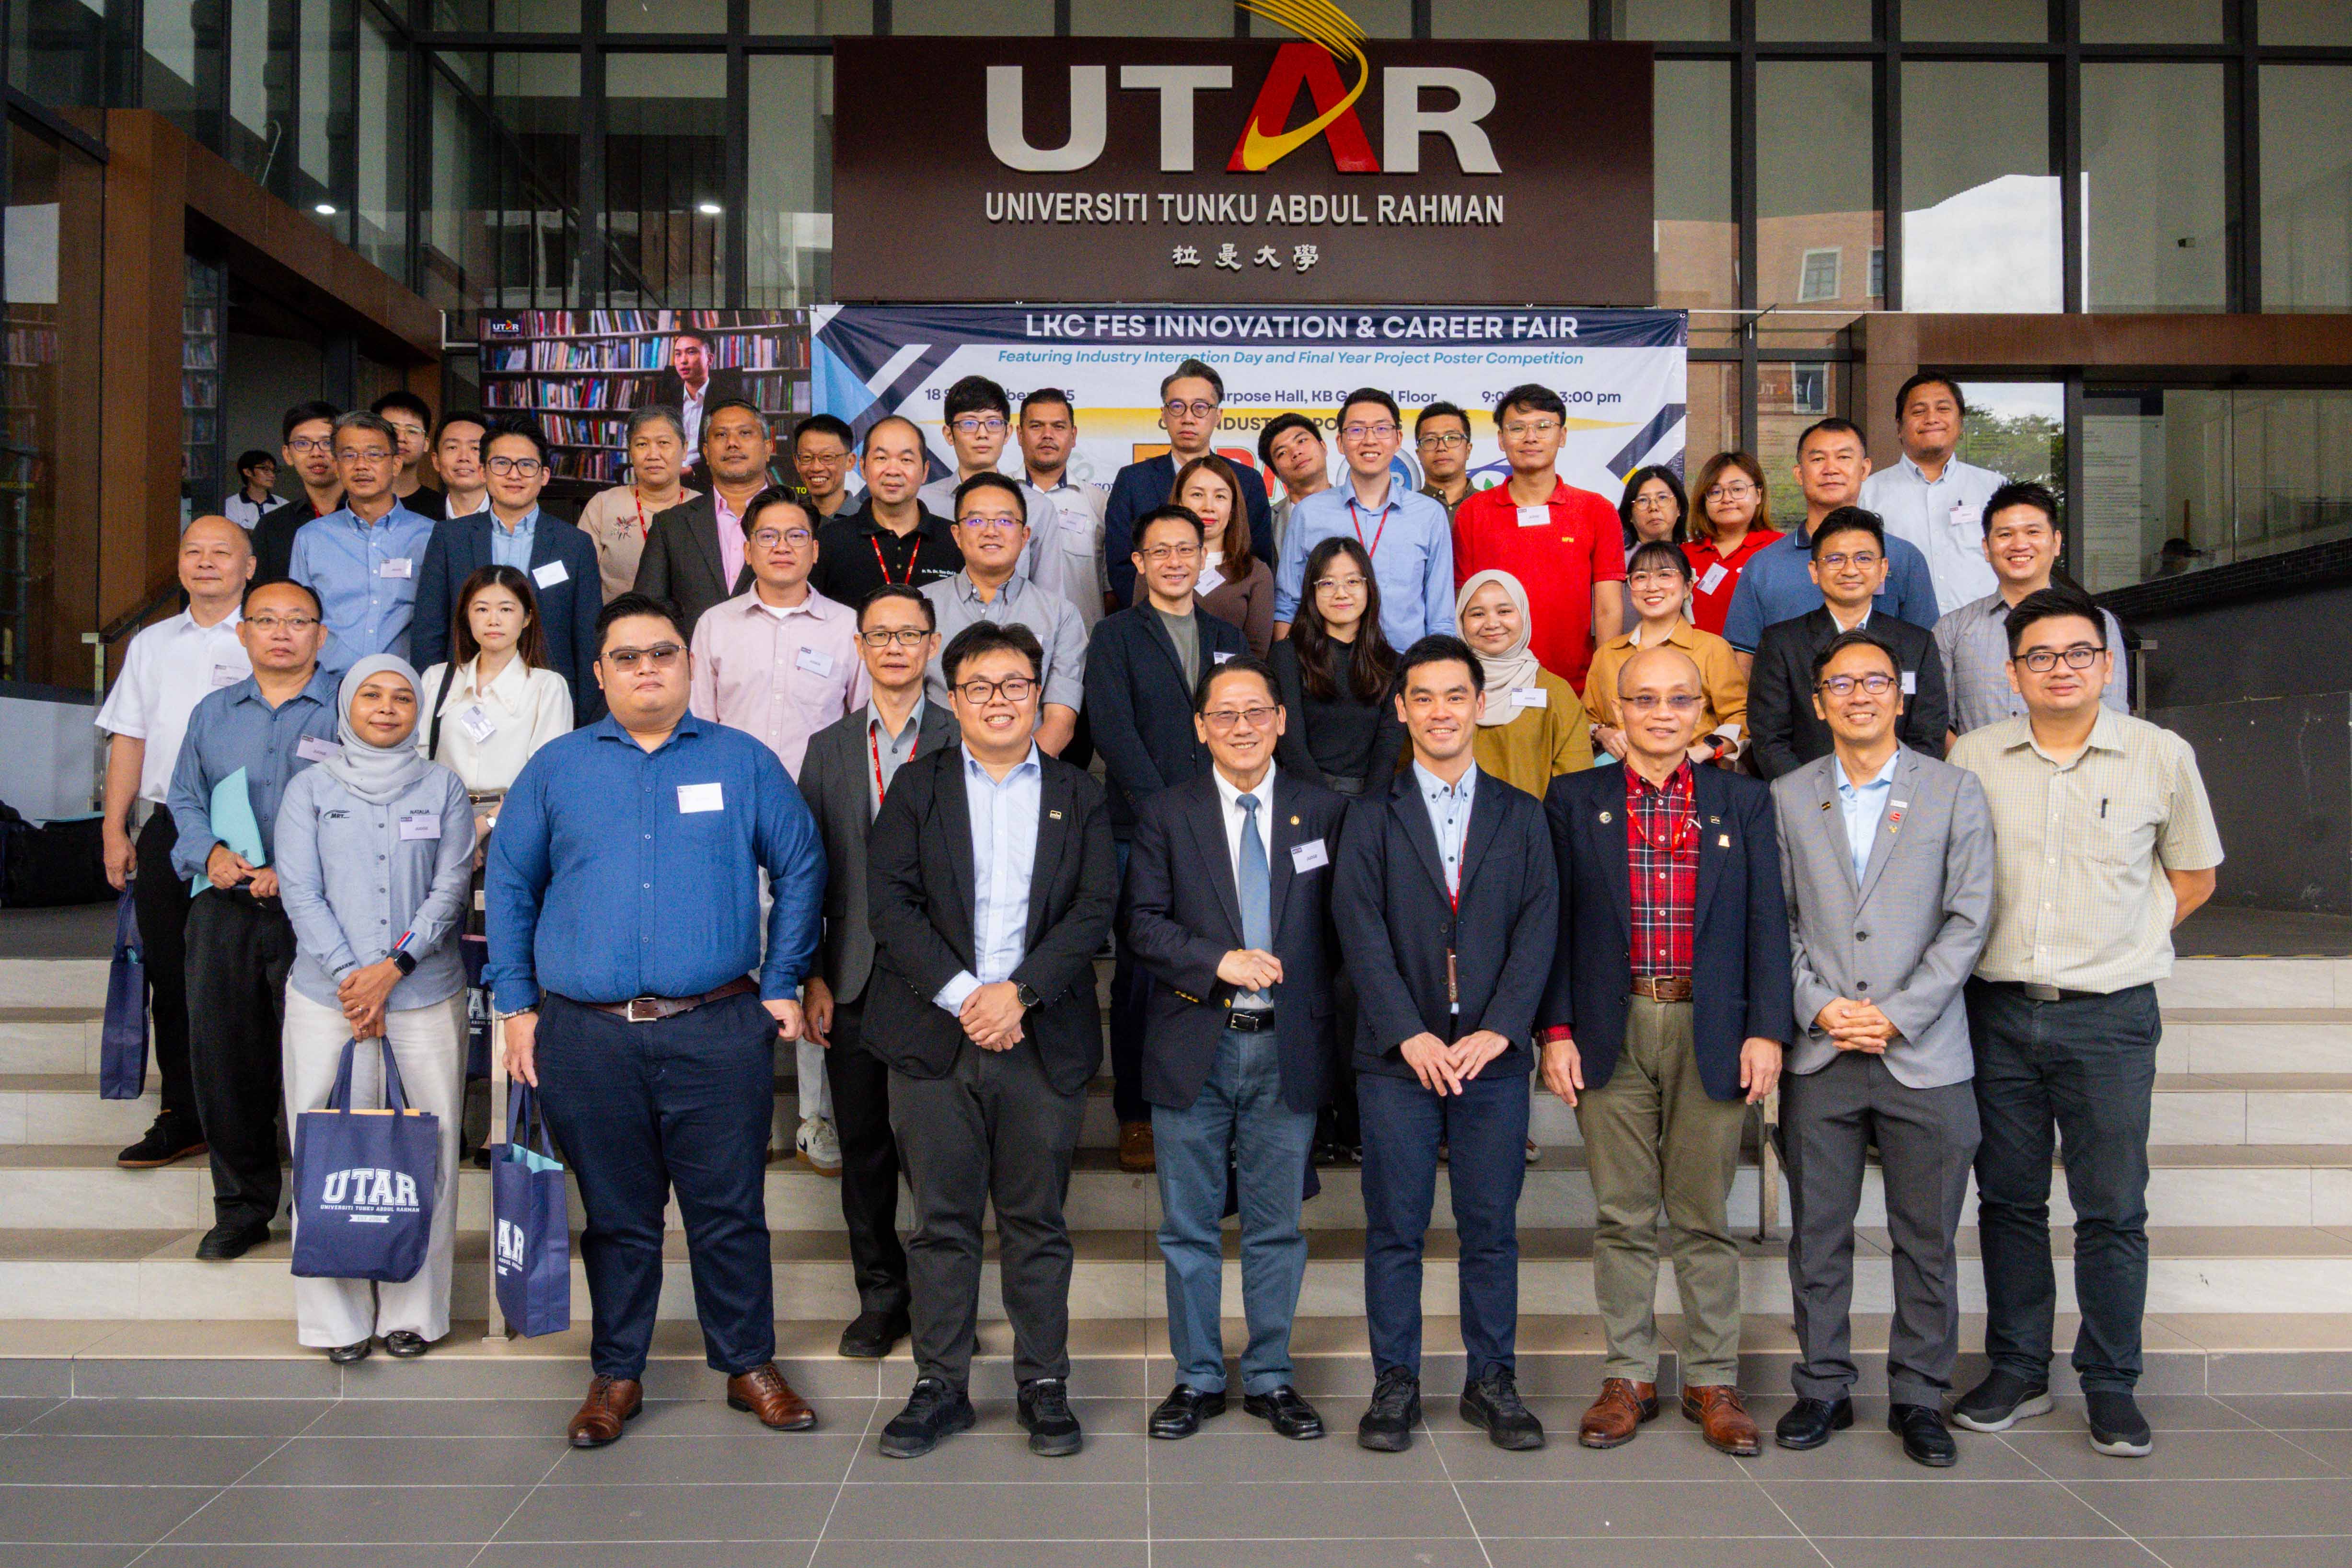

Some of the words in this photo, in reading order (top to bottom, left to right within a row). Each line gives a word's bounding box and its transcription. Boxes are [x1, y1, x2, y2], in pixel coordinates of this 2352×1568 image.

[986, 41, 1503, 174] UTAR
[985, 192, 1147, 222] UNIVERSITI
[1158, 194, 1257, 223] TUNKU
[1266, 195, 1368, 223] ABDUL
[1378, 195, 1503, 223] RAHMAN
[1172, 243, 1319, 271] 拉曼大學
[1026, 314, 1086, 337] LKC
[1095, 315, 1146, 337] FES
[1155, 315, 1347, 337] INNOVATION
[1356, 316, 1376, 338] &
[1383, 316, 1504, 338] CAREER
[1512, 316, 1578, 338] FAIR
[998, 349, 1072, 365] Featuring
[1076, 350, 1141, 365] Industry
[1144, 350, 1230, 363] Interaction
[1233, 351, 1263, 365] Day
[1265, 351, 1296, 363] and
[1298, 351, 1334, 363] Final
[1339, 352, 1372, 364] Year
[1374, 351, 1430, 367] Project
[1433, 351, 1483, 364] Poster
[1485, 351, 1584, 367] Competition
[925, 389, 941, 400] 18
[1275, 390, 1308, 404] Hall,
[1311, 391, 1332, 402] KB
[1398, 391, 1437, 402] Floor
[1482, 391, 1505, 403] 9:0
[1597, 393, 1622, 405] pm
[322, 1168, 419, 1206] UTAR
